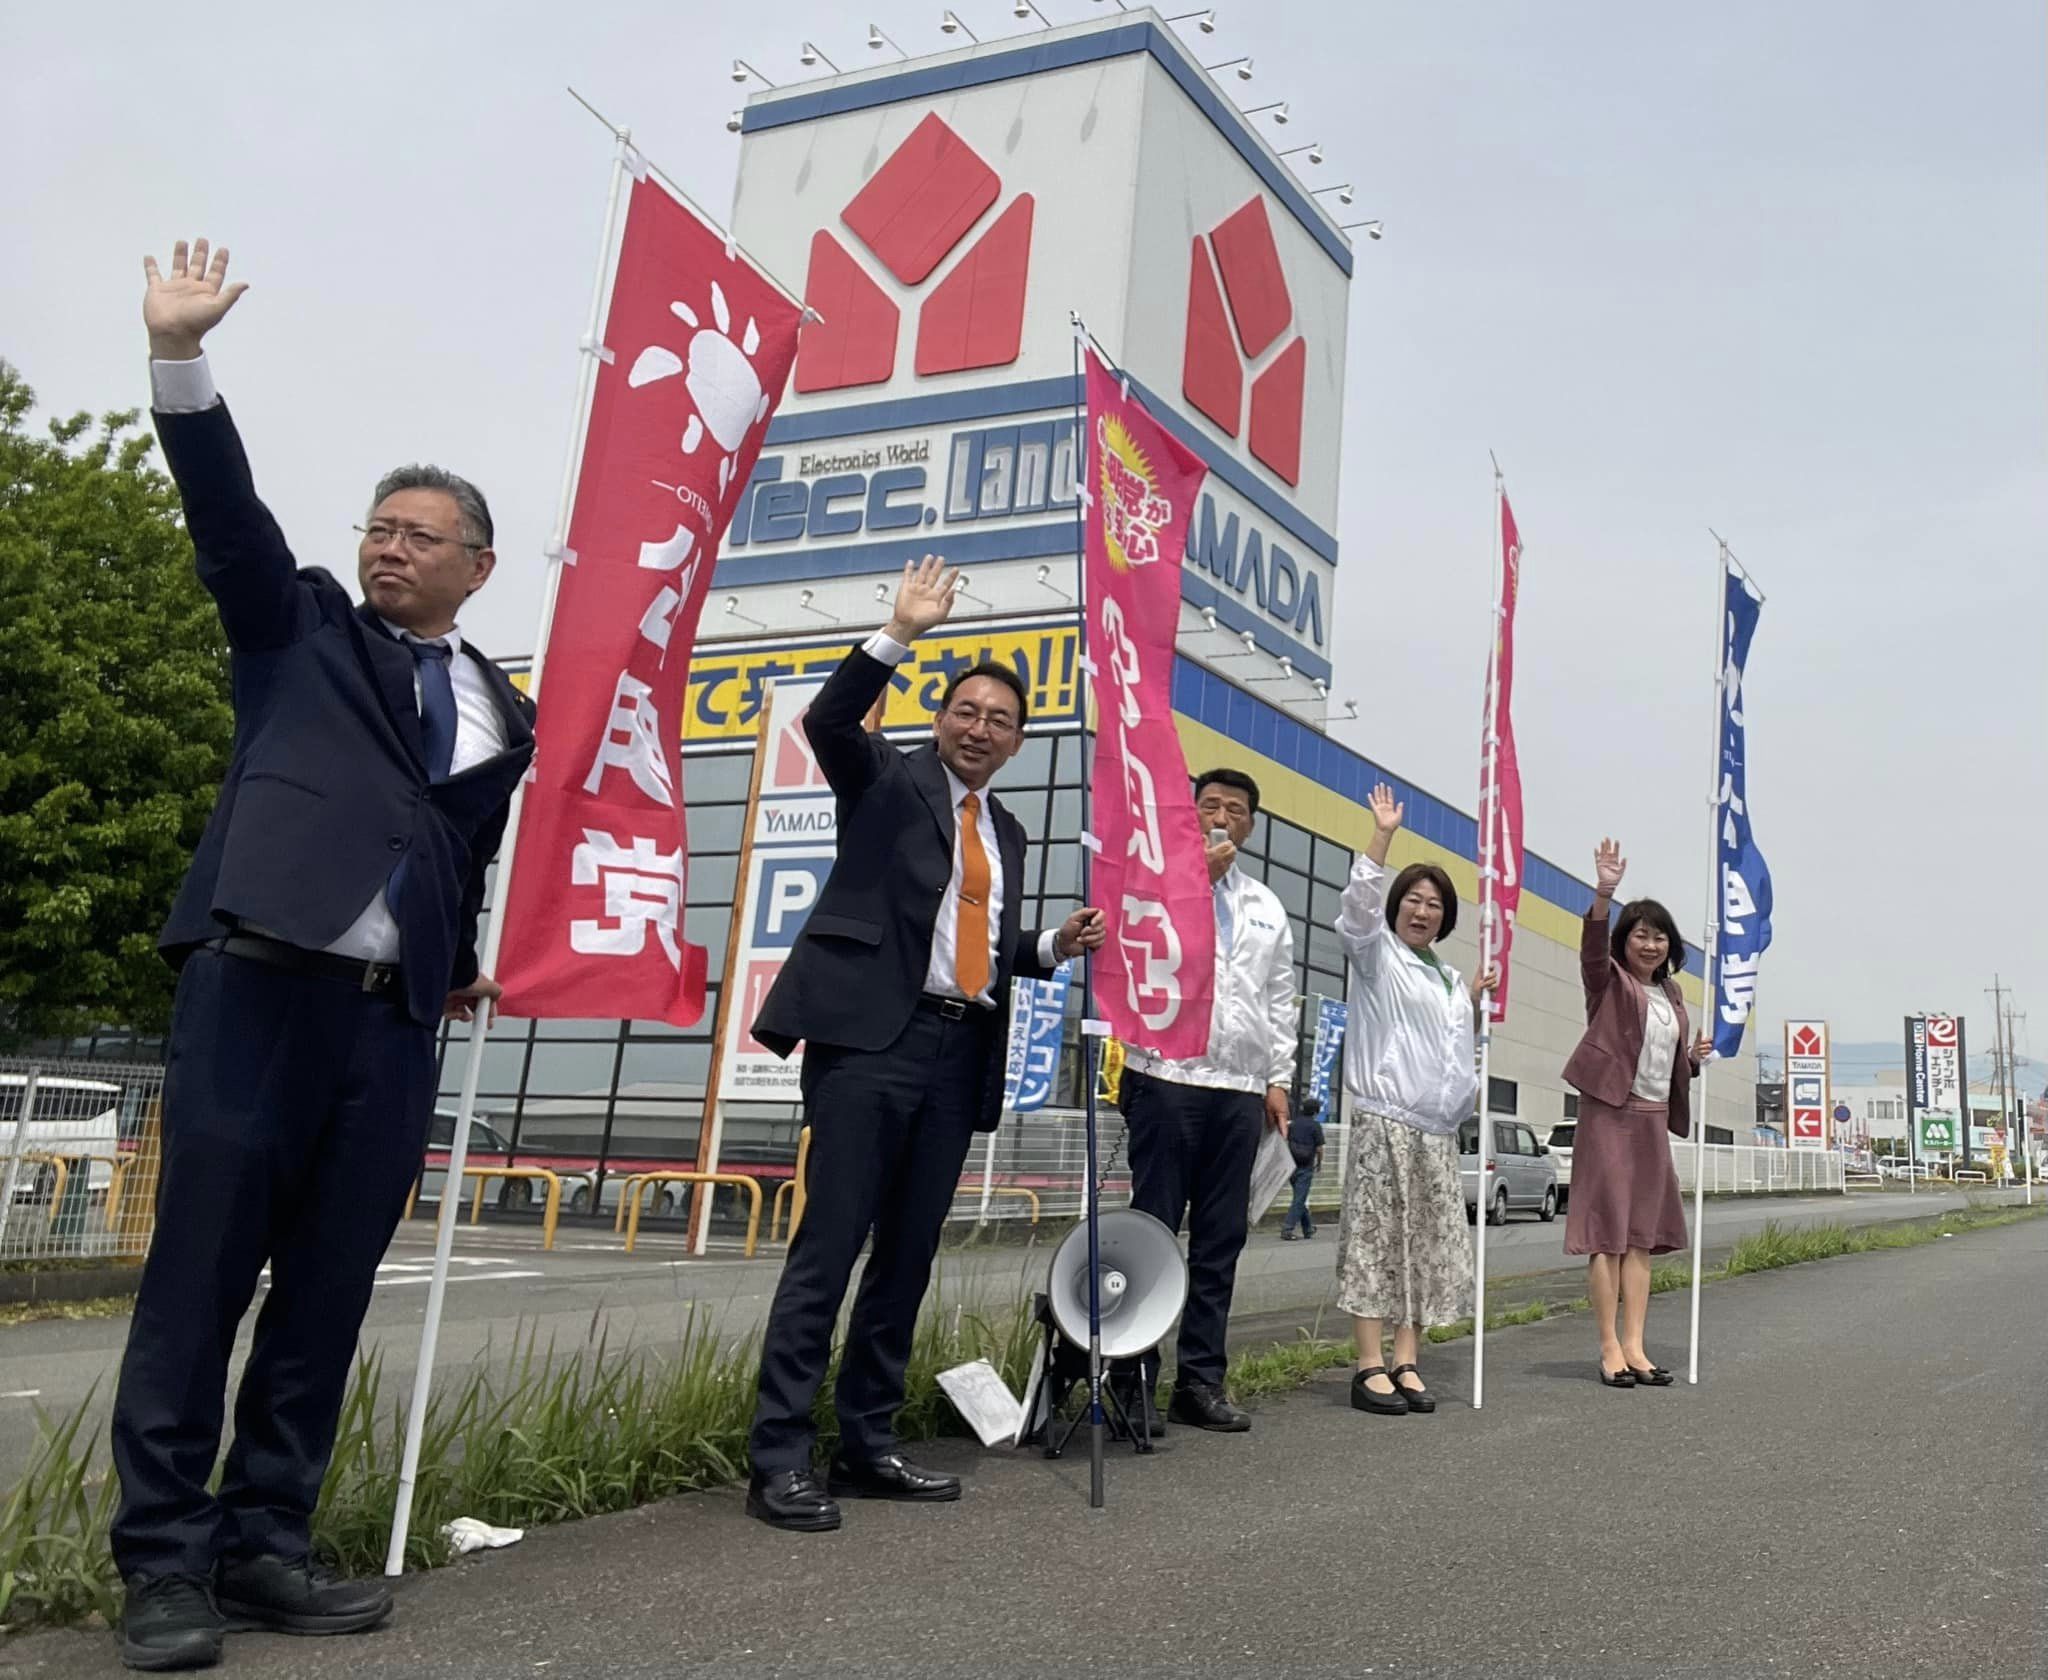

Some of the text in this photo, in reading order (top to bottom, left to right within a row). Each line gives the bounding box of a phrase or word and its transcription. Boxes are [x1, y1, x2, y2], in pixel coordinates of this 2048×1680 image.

[799, 440, 930, 475] Electronics World
[946, 420, 1086, 520] Land
[766, 870, 817, 934] P
[1018, 979, 1065, 1104] エアコン
[1914, 1022, 1926, 1103] DIY Home Center
